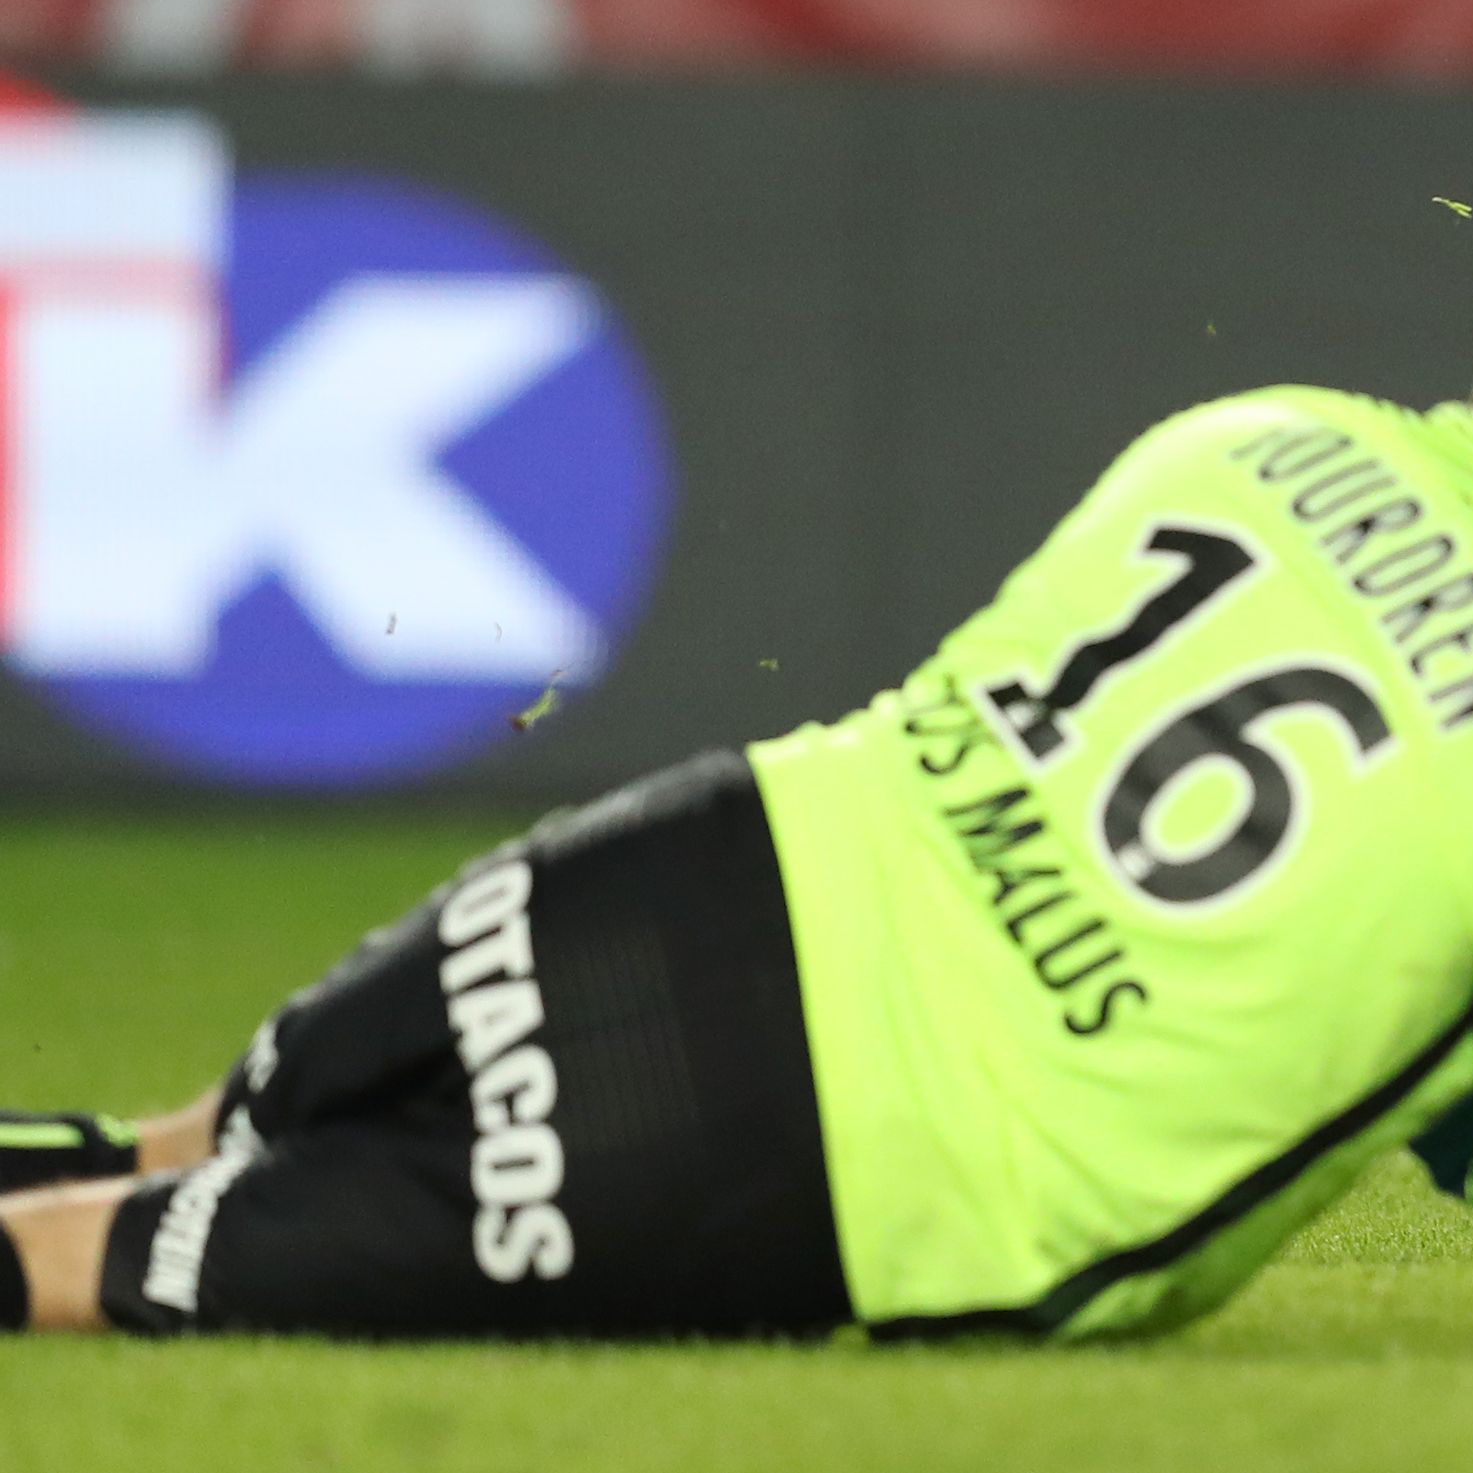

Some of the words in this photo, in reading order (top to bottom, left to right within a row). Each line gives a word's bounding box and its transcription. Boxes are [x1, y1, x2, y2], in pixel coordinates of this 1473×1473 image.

[942, 785, 1150, 1036] MALUS
[980, 520, 1398, 912] 16
[437, 860, 574, 1283] OTACOS
